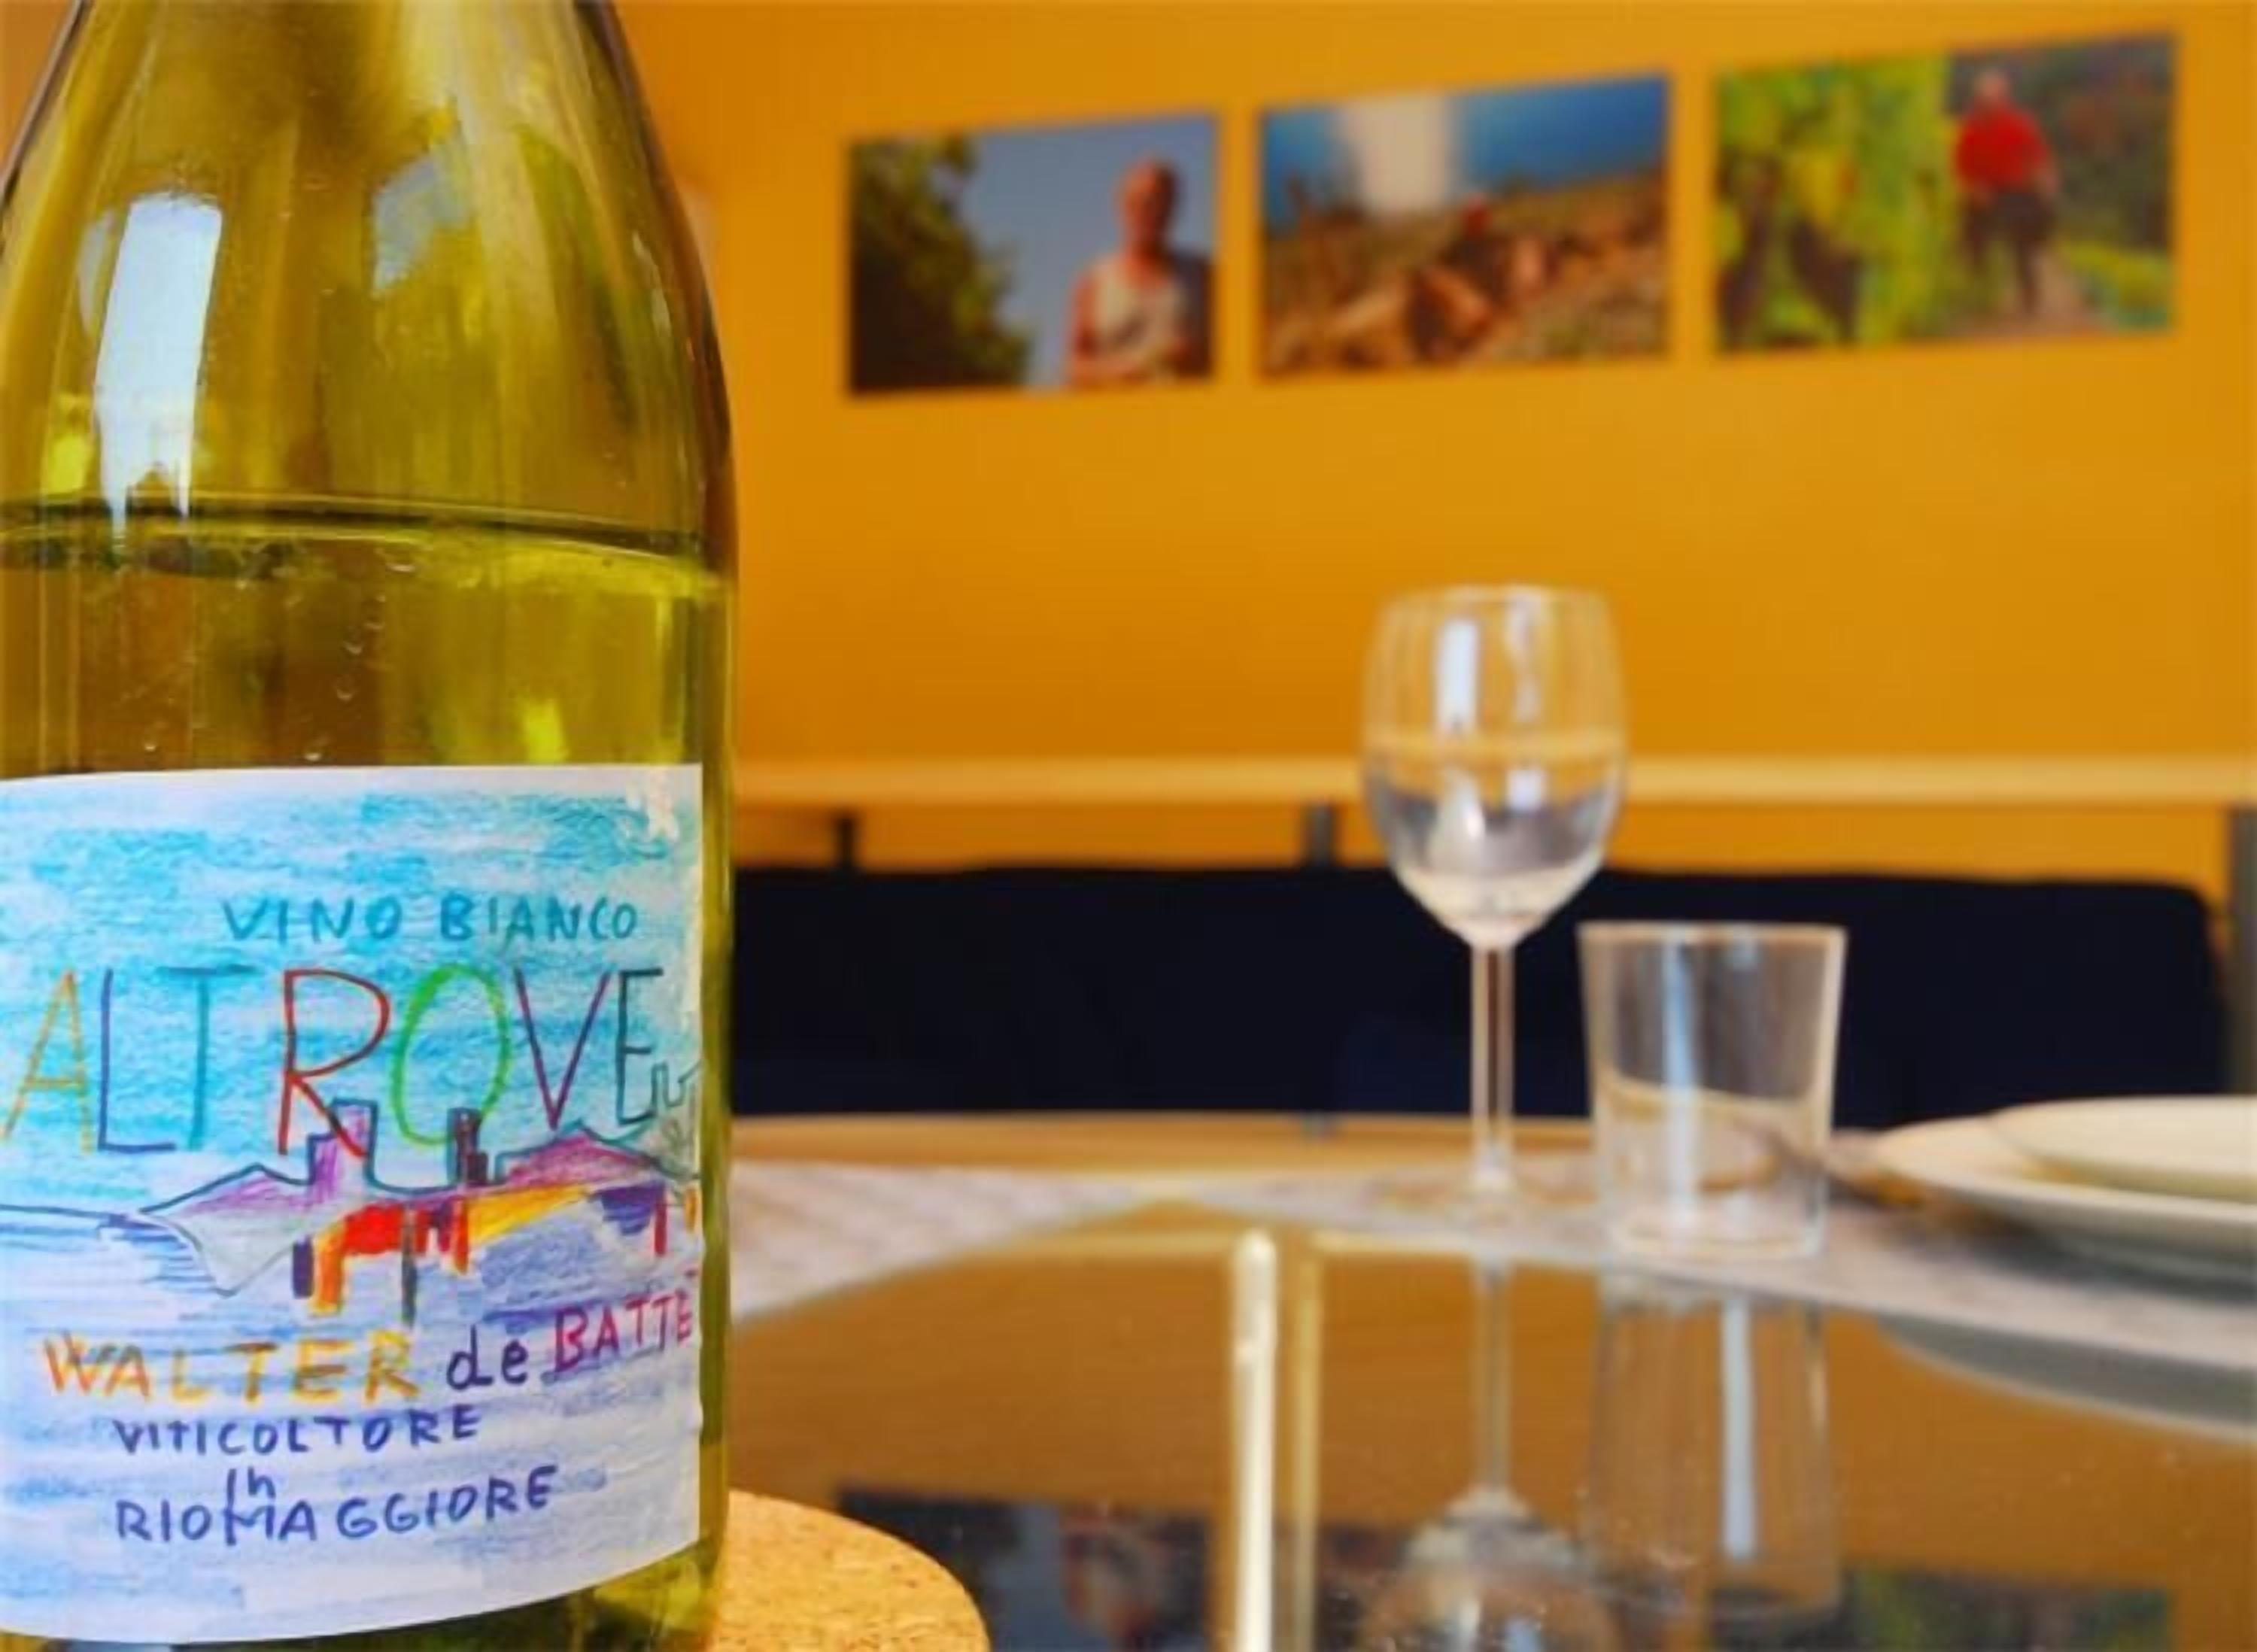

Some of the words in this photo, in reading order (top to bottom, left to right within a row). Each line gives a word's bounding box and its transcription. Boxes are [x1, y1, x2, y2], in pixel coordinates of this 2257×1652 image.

[223, 901, 402, 942] VINO
[439, 895, 637, 942] BIANCO
[2, 963, 664, 1159] ALTROVE
[43, 1330, 419, 1405] WALTER
[445, 1326, 529, 1392] de
[113, 1403, 481, 1455] VITICOLTORE
[116, 1465, 557, 1545] RIOMAGGIORE
